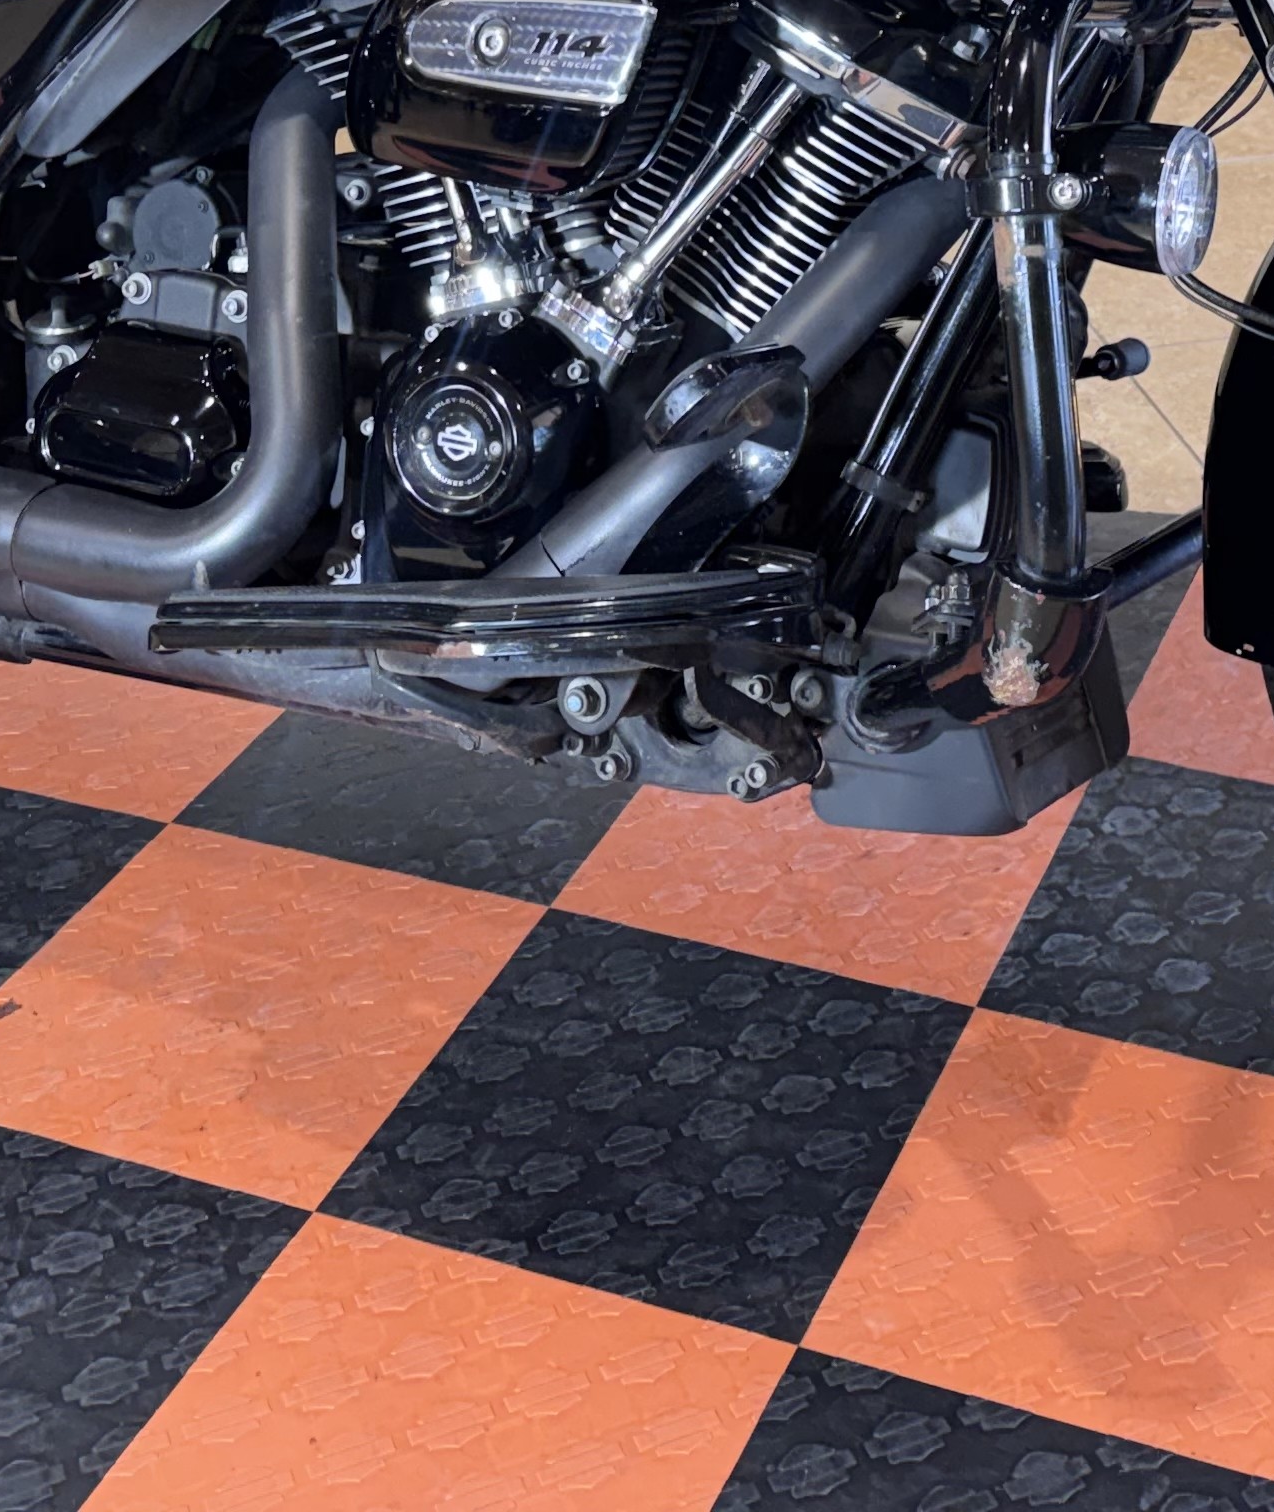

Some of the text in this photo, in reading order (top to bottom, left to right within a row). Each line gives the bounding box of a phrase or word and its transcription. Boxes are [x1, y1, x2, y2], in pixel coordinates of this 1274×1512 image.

[529, 31, 612, 61] 114
[523, 57, 604, 72] CUBIC INCHES
